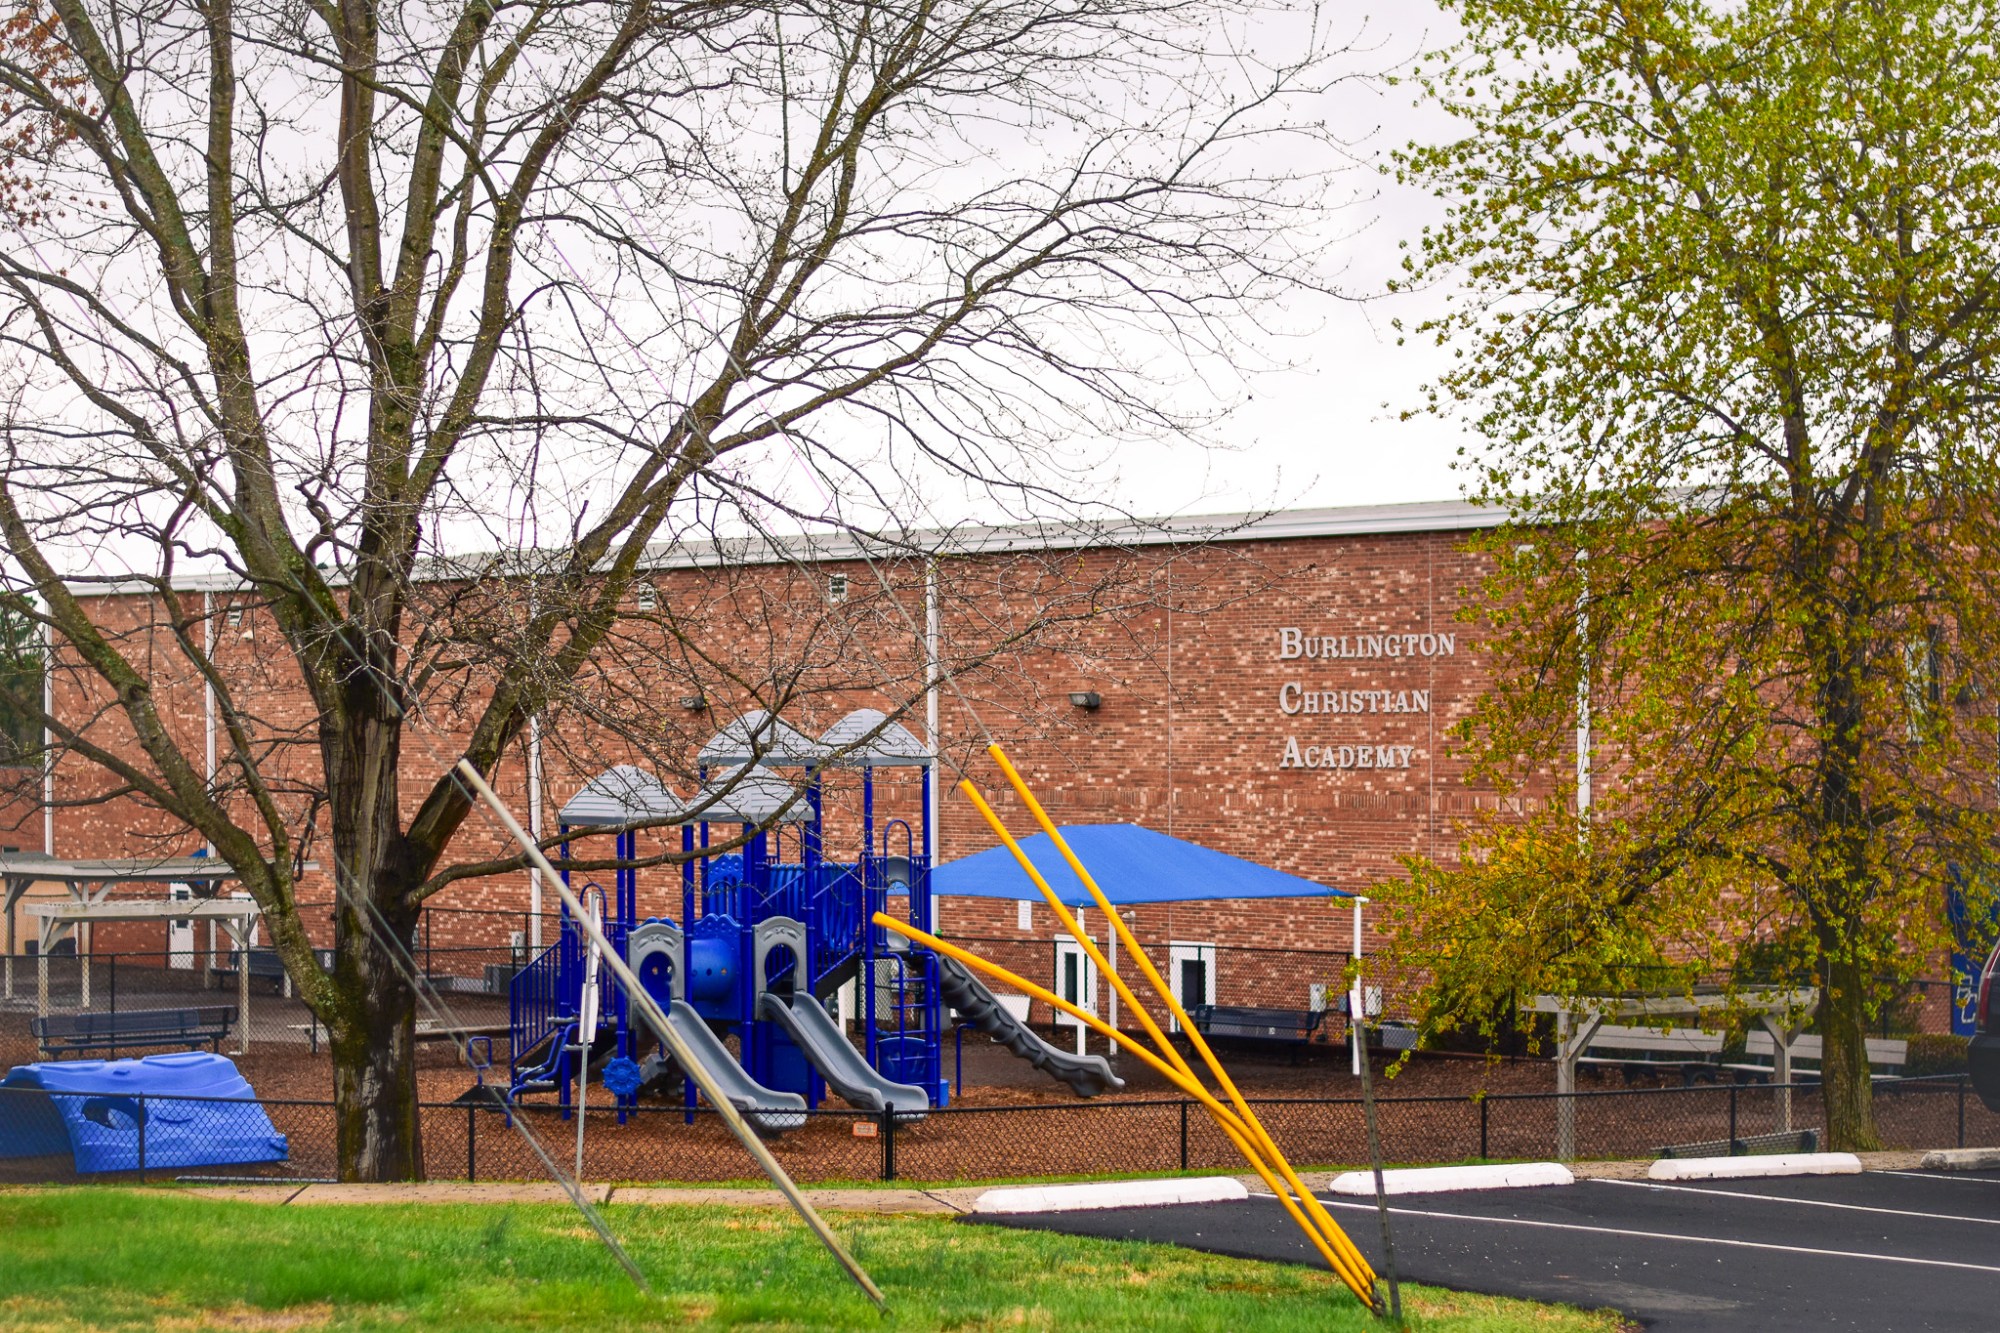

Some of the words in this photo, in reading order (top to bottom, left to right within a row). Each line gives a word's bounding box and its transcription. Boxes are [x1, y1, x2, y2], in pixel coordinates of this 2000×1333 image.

[1279, 627, 1456, 659] BURLINGTON
[1279, 681, 1430, 714] CHRISTIAN
[1279, 736, 1414, 768] ACADEMY
